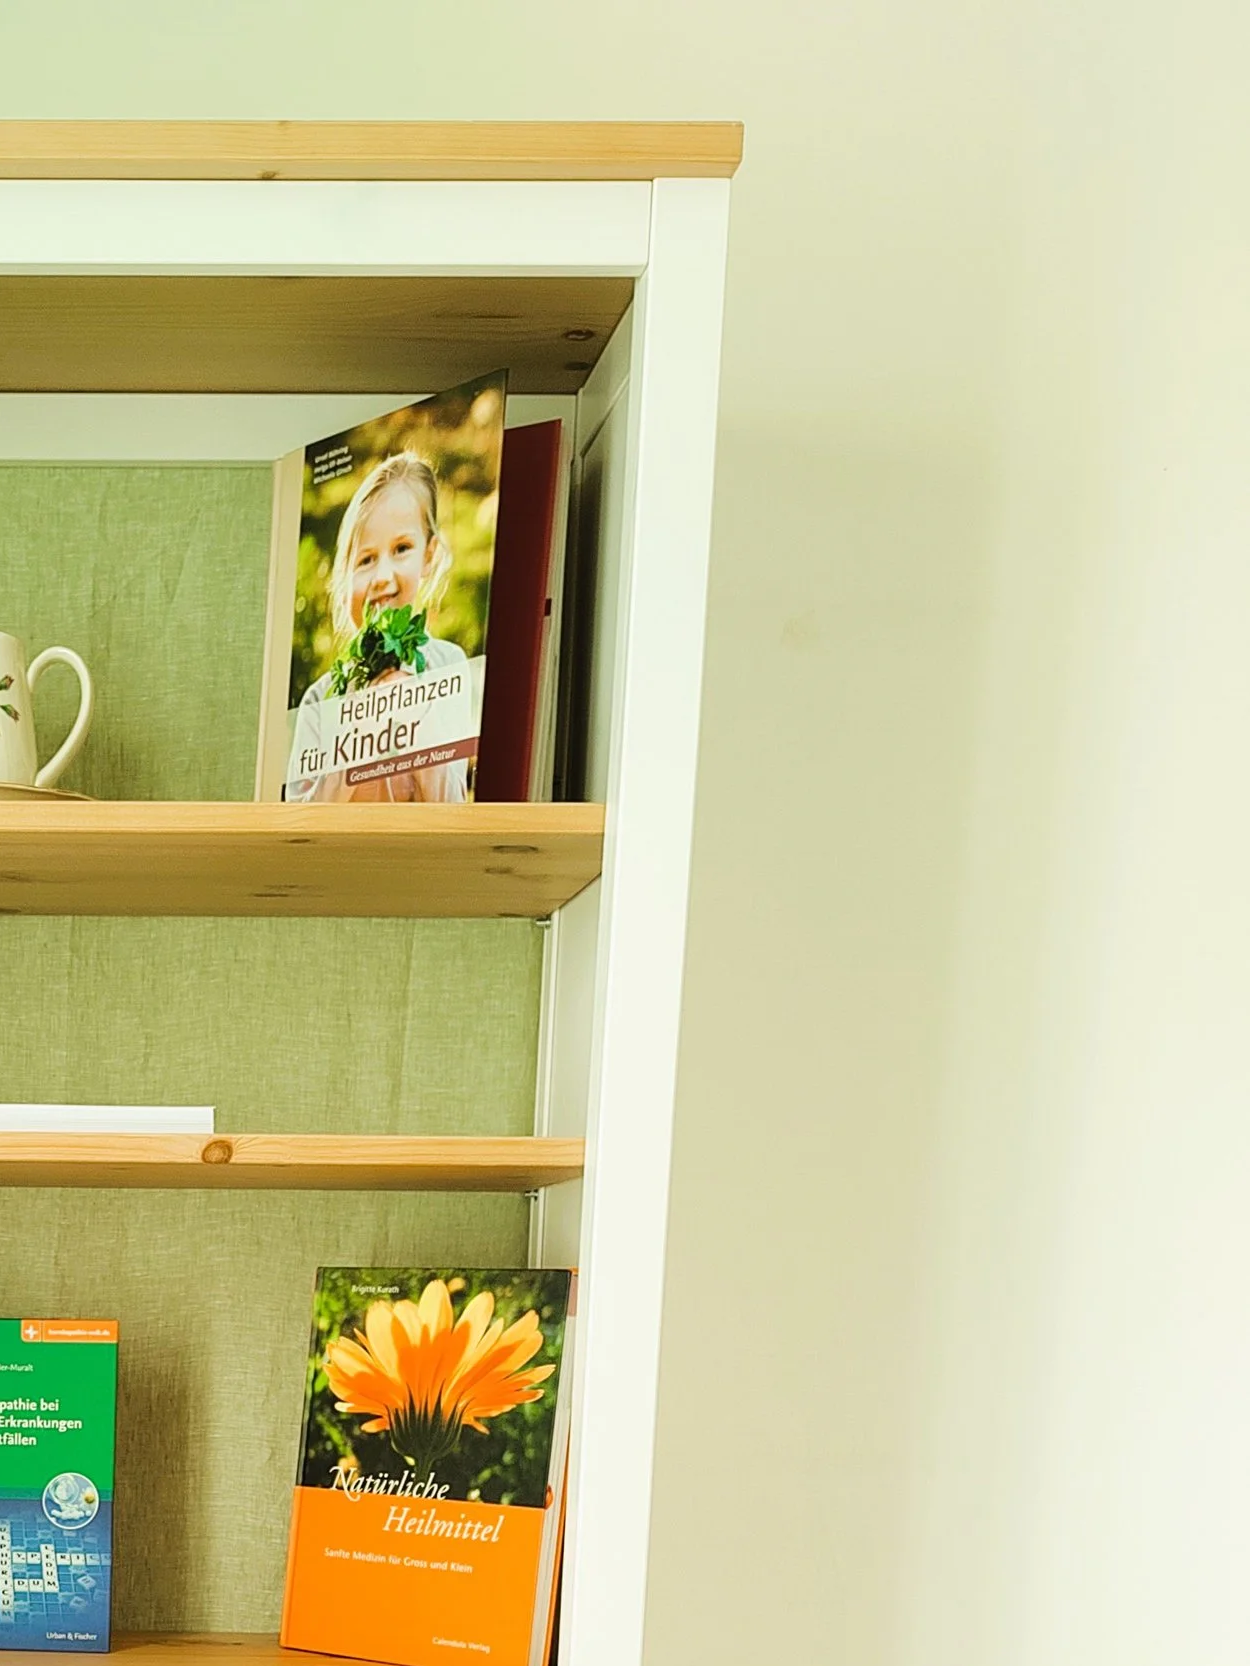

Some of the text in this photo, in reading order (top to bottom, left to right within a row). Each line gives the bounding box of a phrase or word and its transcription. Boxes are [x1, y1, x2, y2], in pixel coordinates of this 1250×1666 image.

[340, 674, 462, 725] Heilpflanzen
[299, 718, 421, 775] für Kinder
[350, 748, 457, 781] Gesundheit aus der Natur
[351, 1285, 376, 1295] Brigitte
[40, 1398, 60, 1411] bei
[328, 1465, 450, 1502] Natürliche
[382, 1505, 505, 1543] Heilmittel
[324, 1547, 473, 1574] Sanfte Medizin für Gross und Klein
[45, 1631, 98, 1641] Urban & Fischer
[468, 1641, 491, 1654] Verlag
